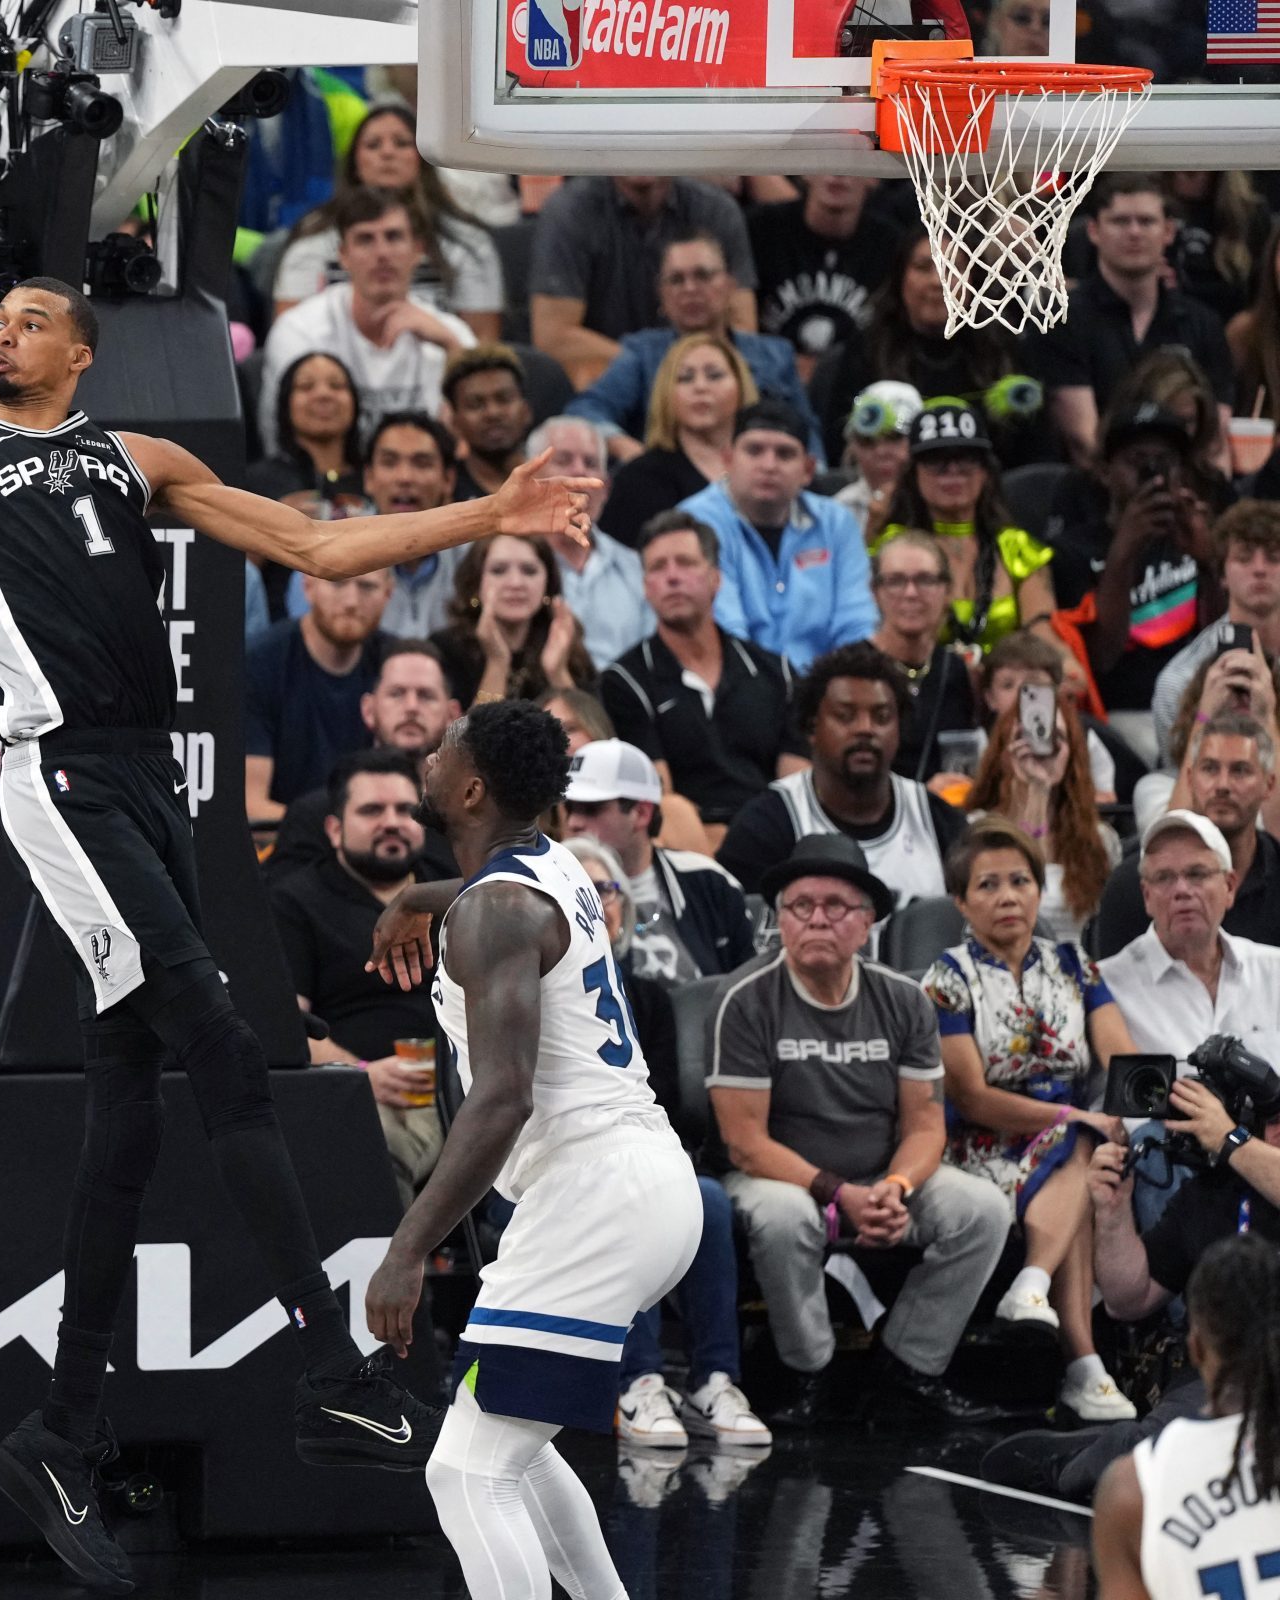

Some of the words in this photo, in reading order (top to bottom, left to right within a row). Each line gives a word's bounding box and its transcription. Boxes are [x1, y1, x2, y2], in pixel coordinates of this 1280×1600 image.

[533, 38, 560, 61] NBA
[919, 410, 977, 442] 210
[80, 438, 111, 450] LEDGER
[71, 494, 116, 557] 1
[582, 955, 641, 1069] 3
[777, 1038, 890, 1064] SPURS
